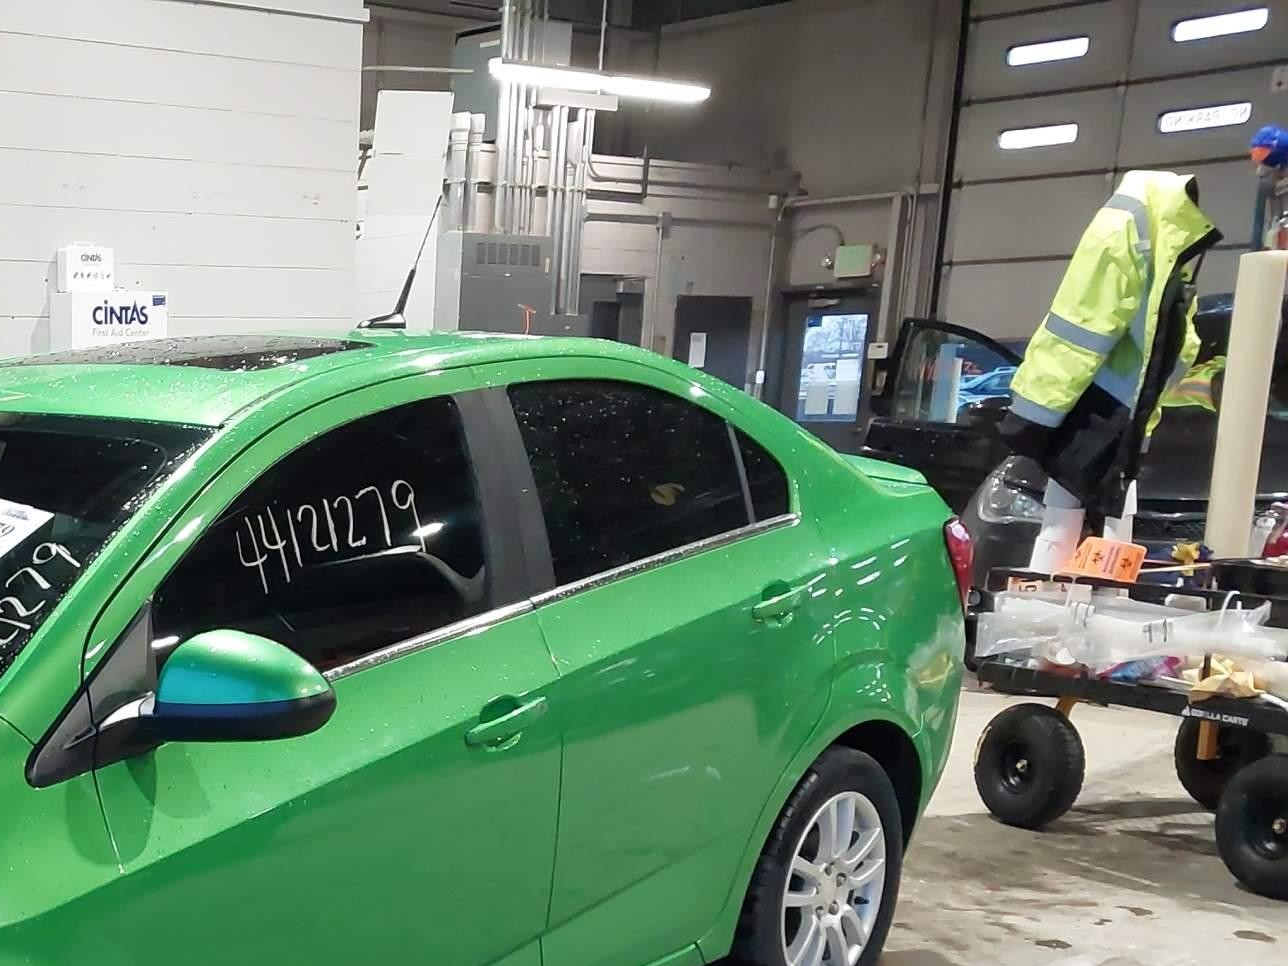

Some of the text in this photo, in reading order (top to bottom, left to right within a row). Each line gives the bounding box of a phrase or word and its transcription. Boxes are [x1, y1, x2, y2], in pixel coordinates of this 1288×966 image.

[92, 328, 150, 337] First Aid Center
[235, 479, 427, 595] 44121279
